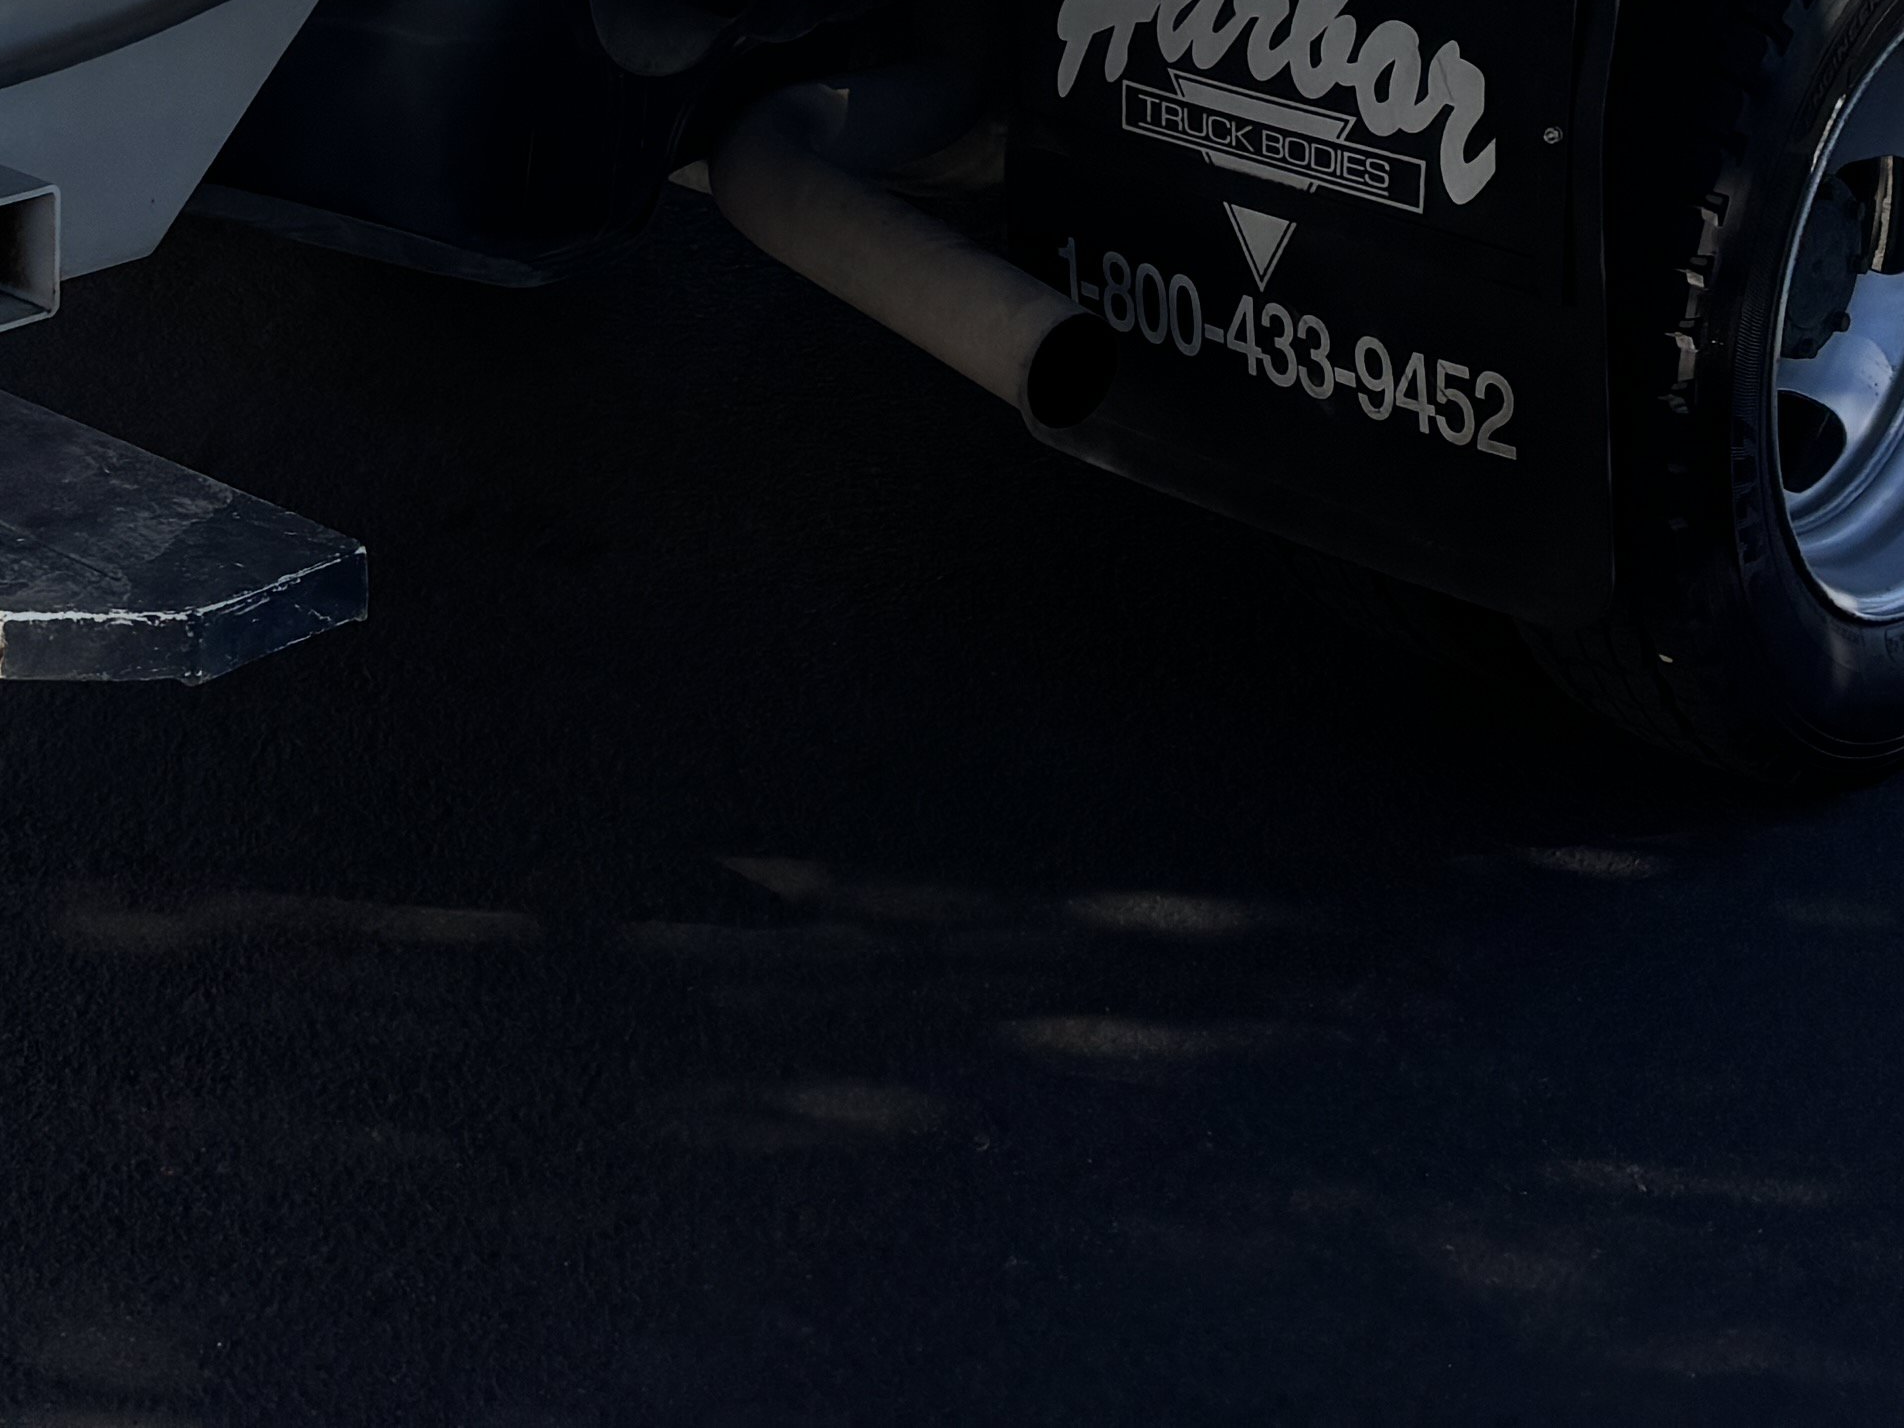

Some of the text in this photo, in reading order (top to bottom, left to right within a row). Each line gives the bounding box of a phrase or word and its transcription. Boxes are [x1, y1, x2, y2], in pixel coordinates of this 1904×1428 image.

[1138, 94, 1390, 187] TRUCK BODIES
[1056, 236, 1517, 461] 1-800-433-9452
